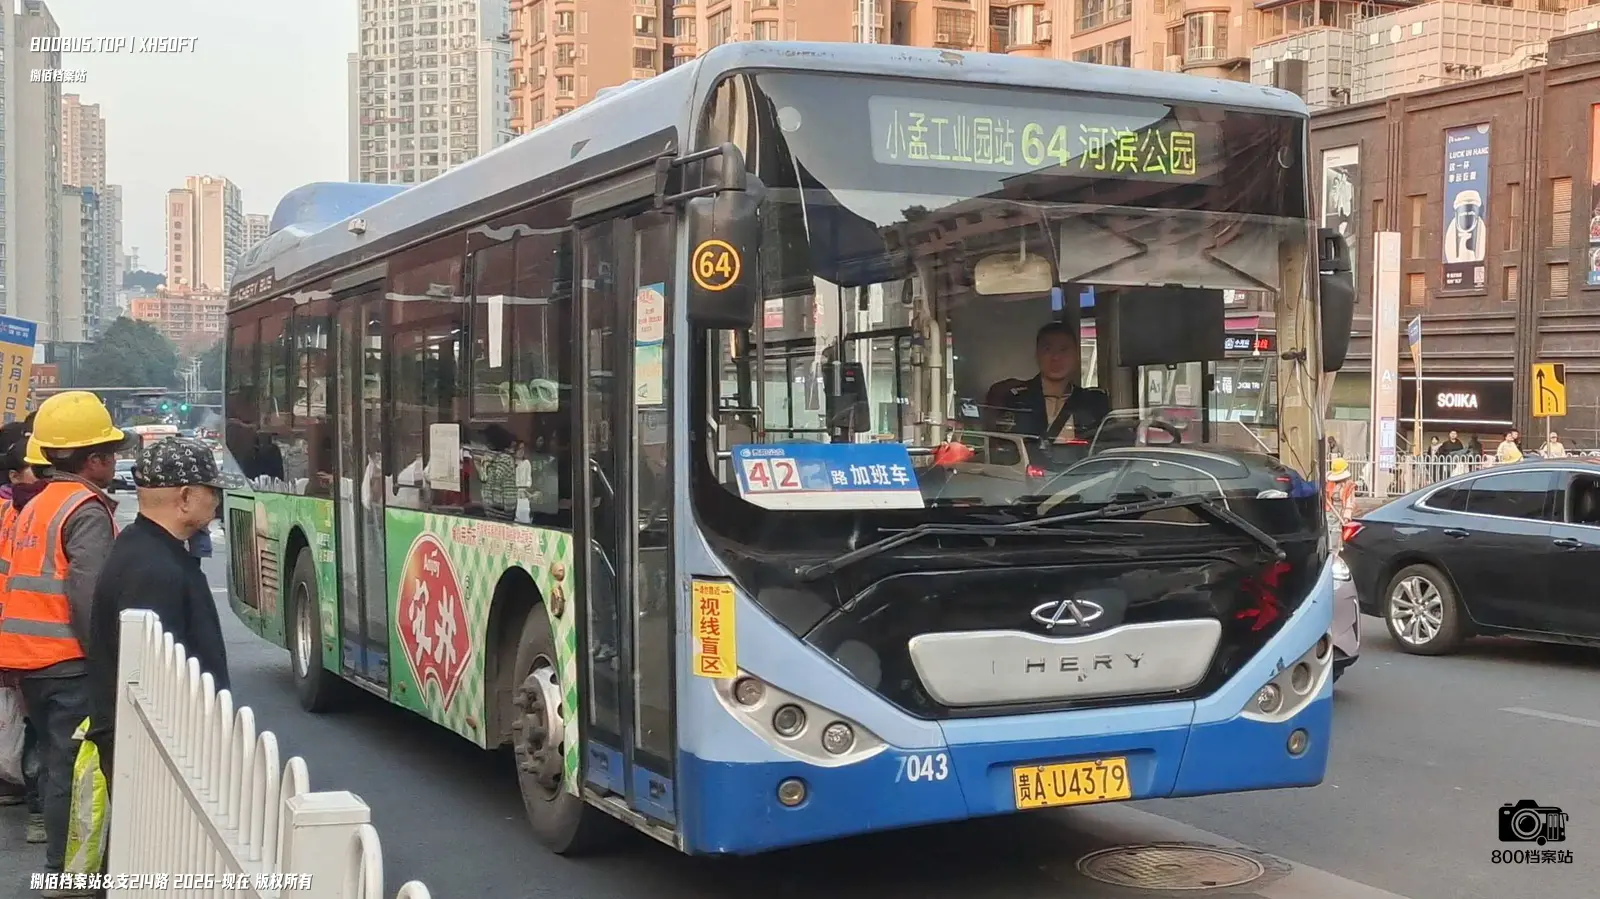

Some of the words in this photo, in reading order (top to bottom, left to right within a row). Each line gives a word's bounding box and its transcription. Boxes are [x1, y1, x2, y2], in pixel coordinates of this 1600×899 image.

[885, 109, 1015, 166] 小孟工业园站
[1021, 122, 1071, 167] 64
[1079, 122, 1196, 176] 河滨公园
[1449, 149, 1465, 160] LUCK
[700, 251, 731, 278] 64
[700, 597, 721, 674] 视线盲区
[992, 653, 1145, 674] HERY
[894, 753, 949, 783] 7043
